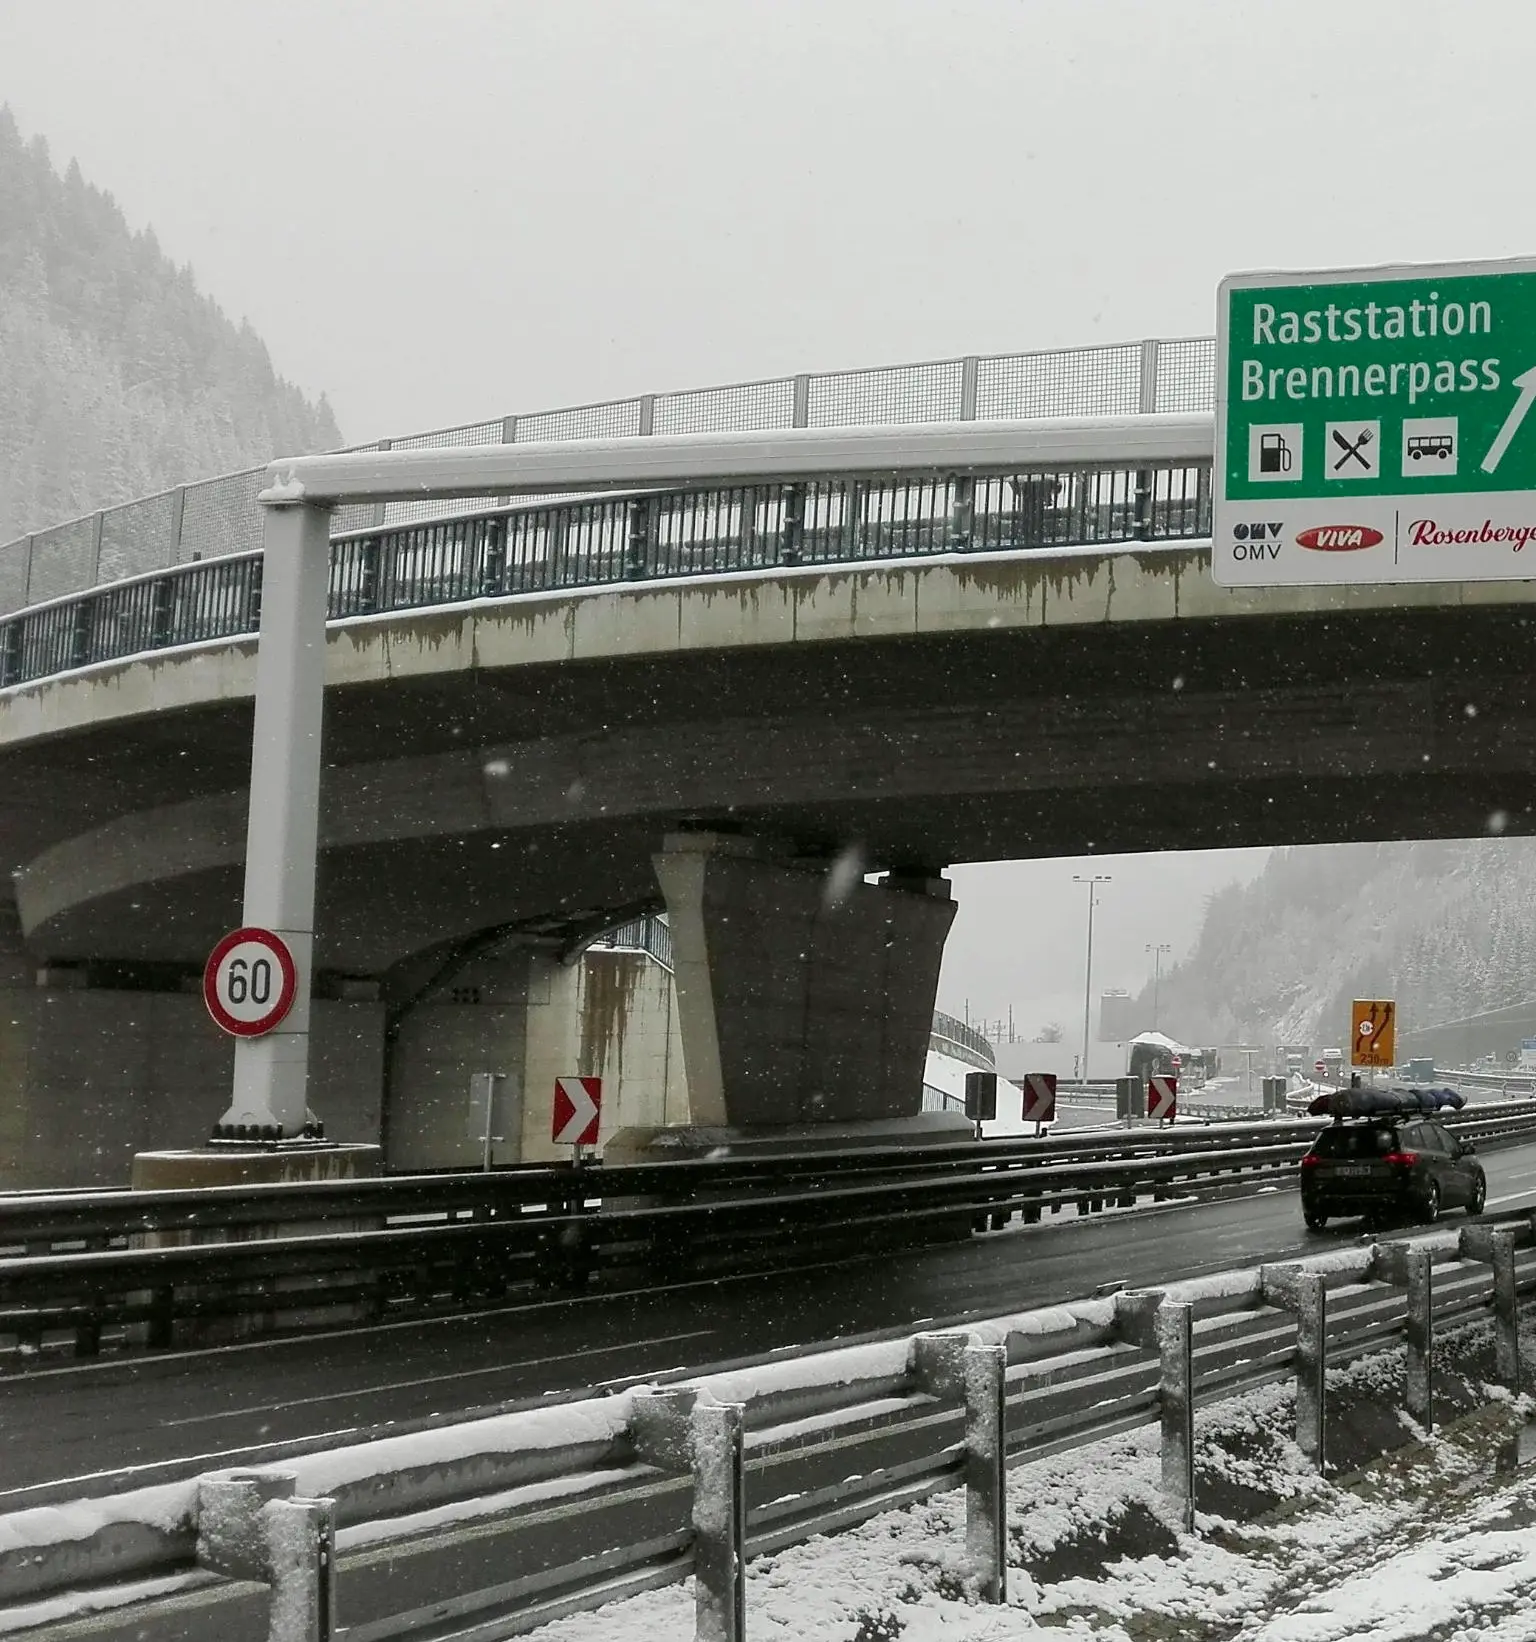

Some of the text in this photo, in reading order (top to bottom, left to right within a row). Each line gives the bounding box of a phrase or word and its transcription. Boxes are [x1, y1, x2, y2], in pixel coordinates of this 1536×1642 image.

[1253, 291, 1491, 345] Raststation
[1242, 358, 1500, 404] Brennerpass
[1233, 544, 1282, 561] OMV
[1316, 529, 1363, 548] VIVA
[228, 958, 270, 1005] 60
